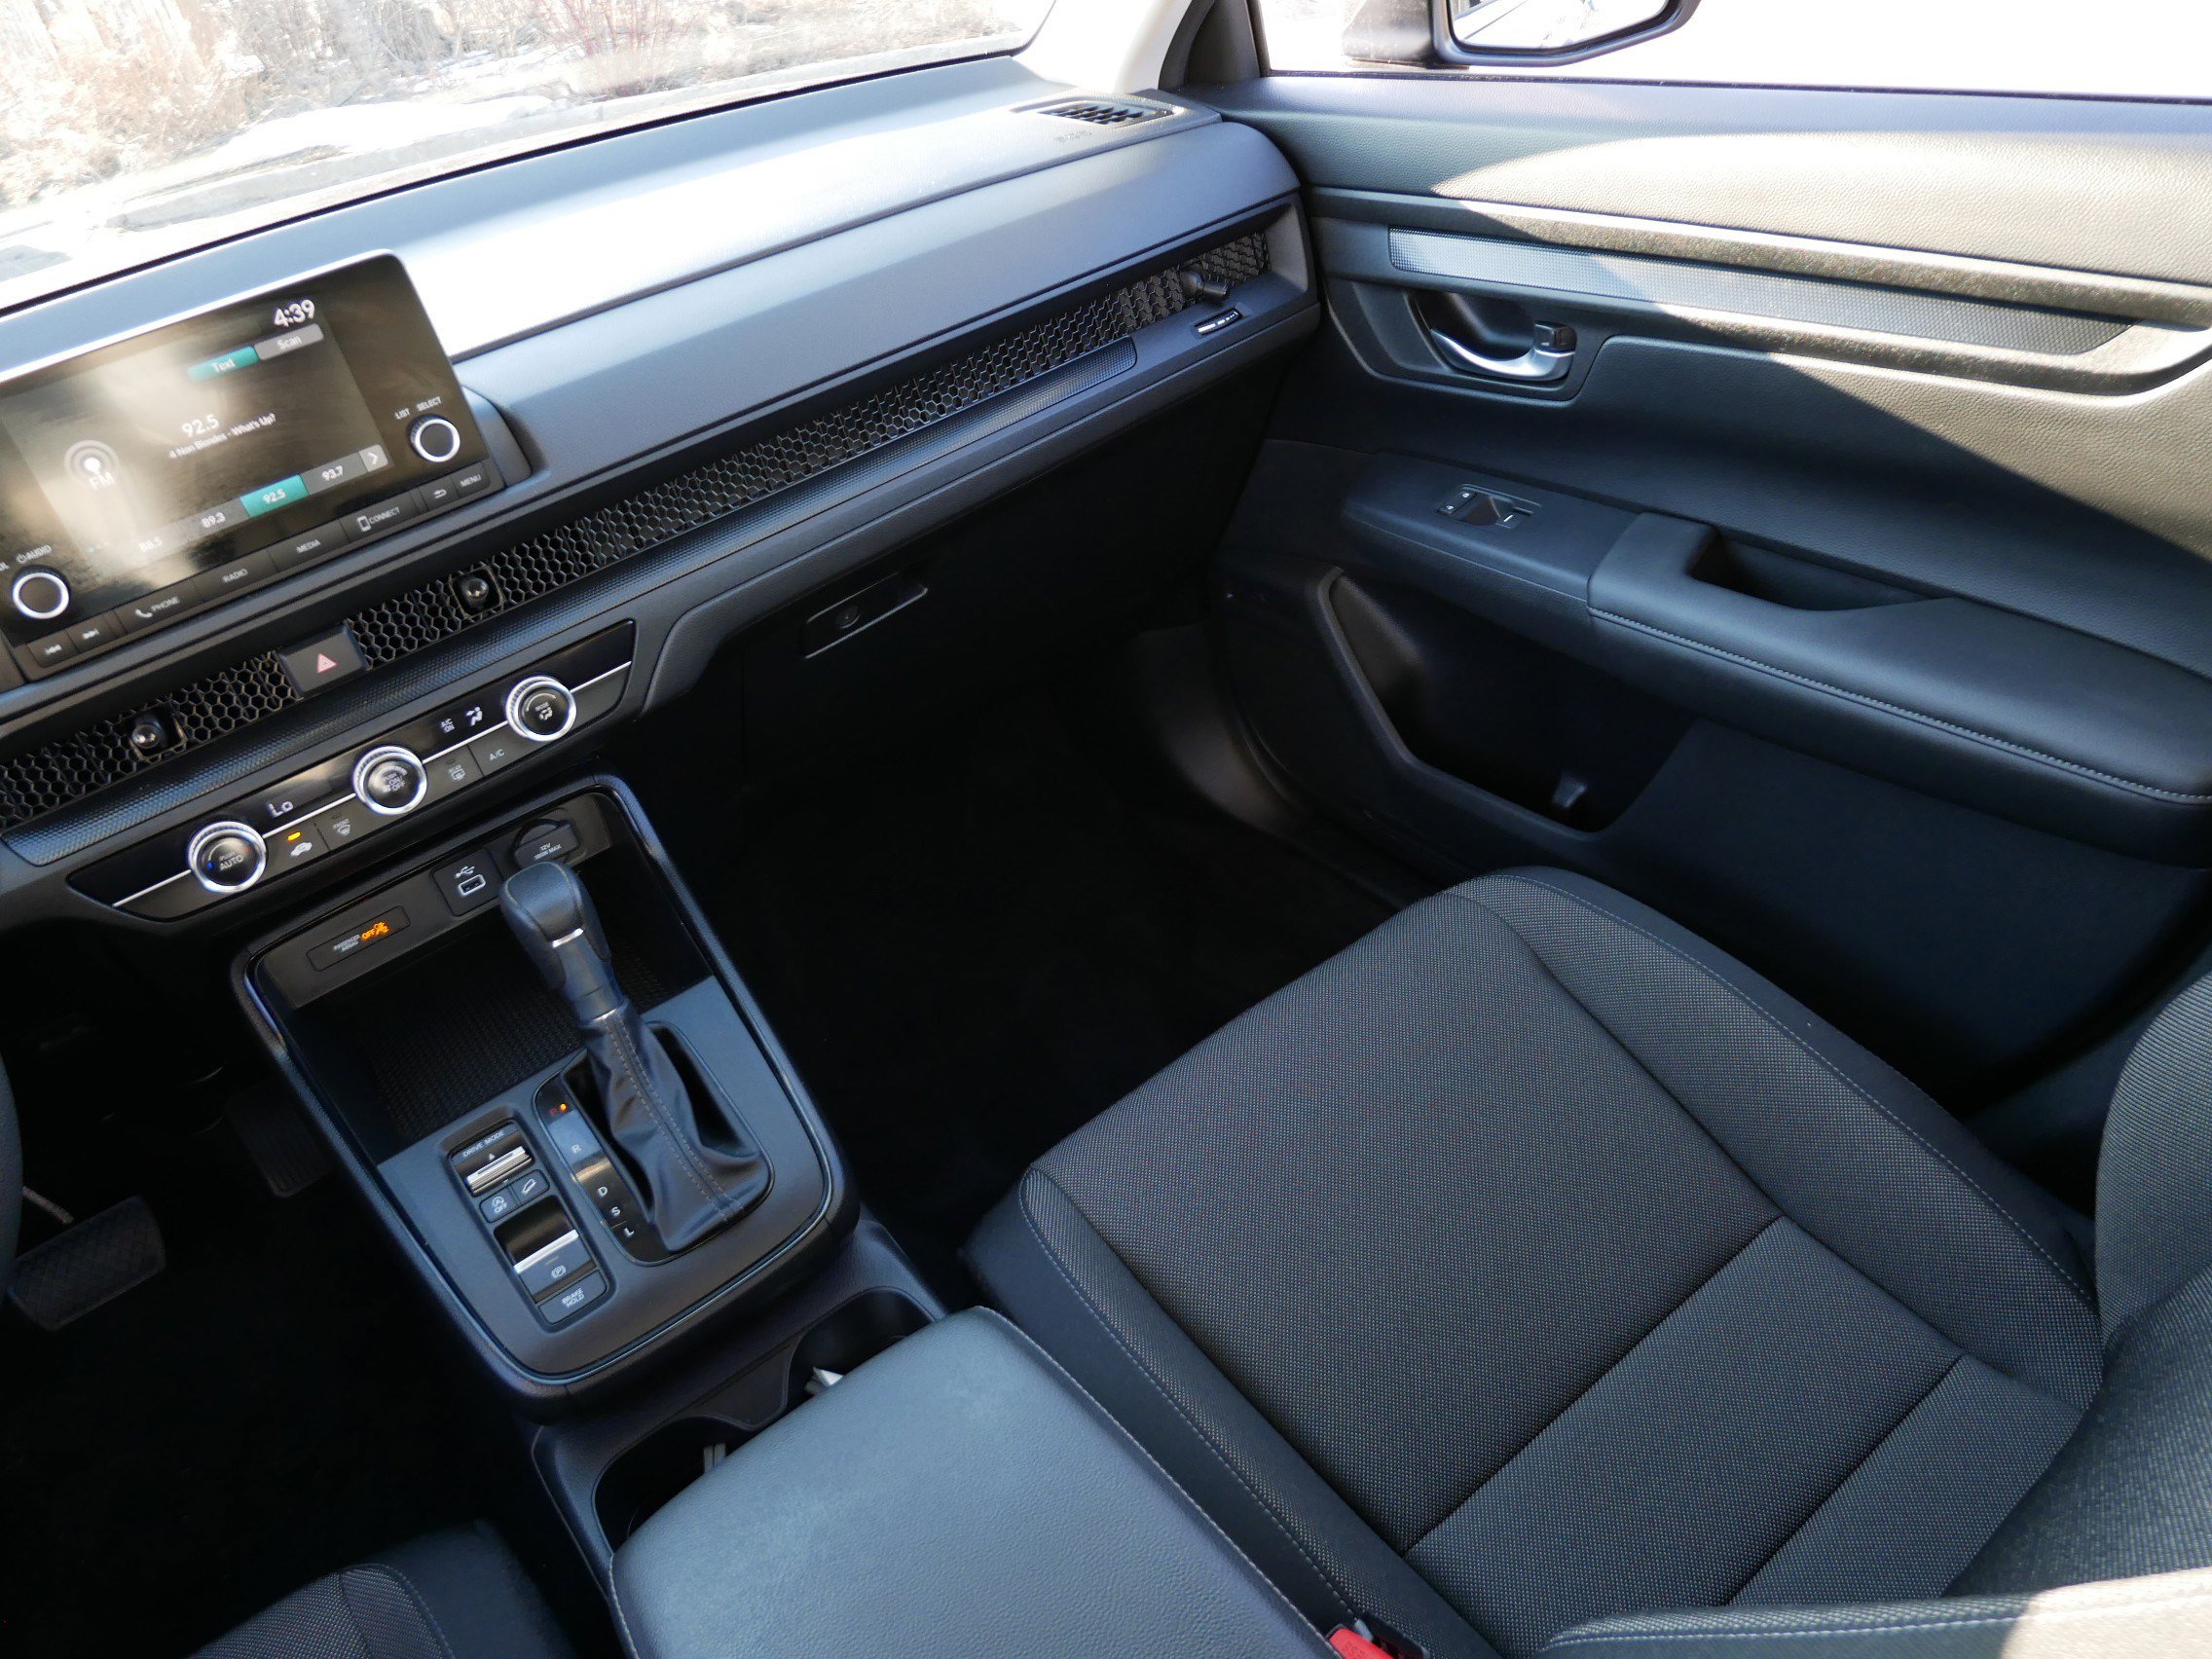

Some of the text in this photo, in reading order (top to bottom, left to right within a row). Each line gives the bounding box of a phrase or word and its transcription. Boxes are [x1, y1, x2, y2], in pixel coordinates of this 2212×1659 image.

[274, 299, 315, 328] 4:39
[276, 336, 303, 350] Scan
[211, 358, 237, 374] Text
[394, 396, 442, 421] LIST SELECT
[182, 413, 219, 437] 92.5
[231, 421, 260, 436] What's
[258, 413, 276, 427] Up?
[89, 471, 116, 491] FM
[460, 474, 482, 488] MENU
[201, 511, 226, 529] 89.3
[262, 488, 286, 504] 92.5
[321, 464, 344, 482] 93.7
[368, 506, 401, 525] CONNECT
[26, 544, 53, 561] AUDIO
[296, 538, 321, 554] MEDIA
[222, 568, 248, 583] RADIO
[151, 595, 180, 612] PHONE
[489, 749, 505, 761] A/C
[268, 799, 294, 818] Lo
[548, 843, 562, 854] MAX
[219, 854, 243, 871] AUTO
[462, 1129, 505, 1158] DRIVE MODE
[571, 1144, 581, 1154] R
[597, 1186, 608, 1198] D
[611, 1206, 621, 1217] S
[623, 1227, 635, 1237] L
[562, 1287, 584, 1306] BRAKE
[566, 1293, 585, 1309] HOLD
